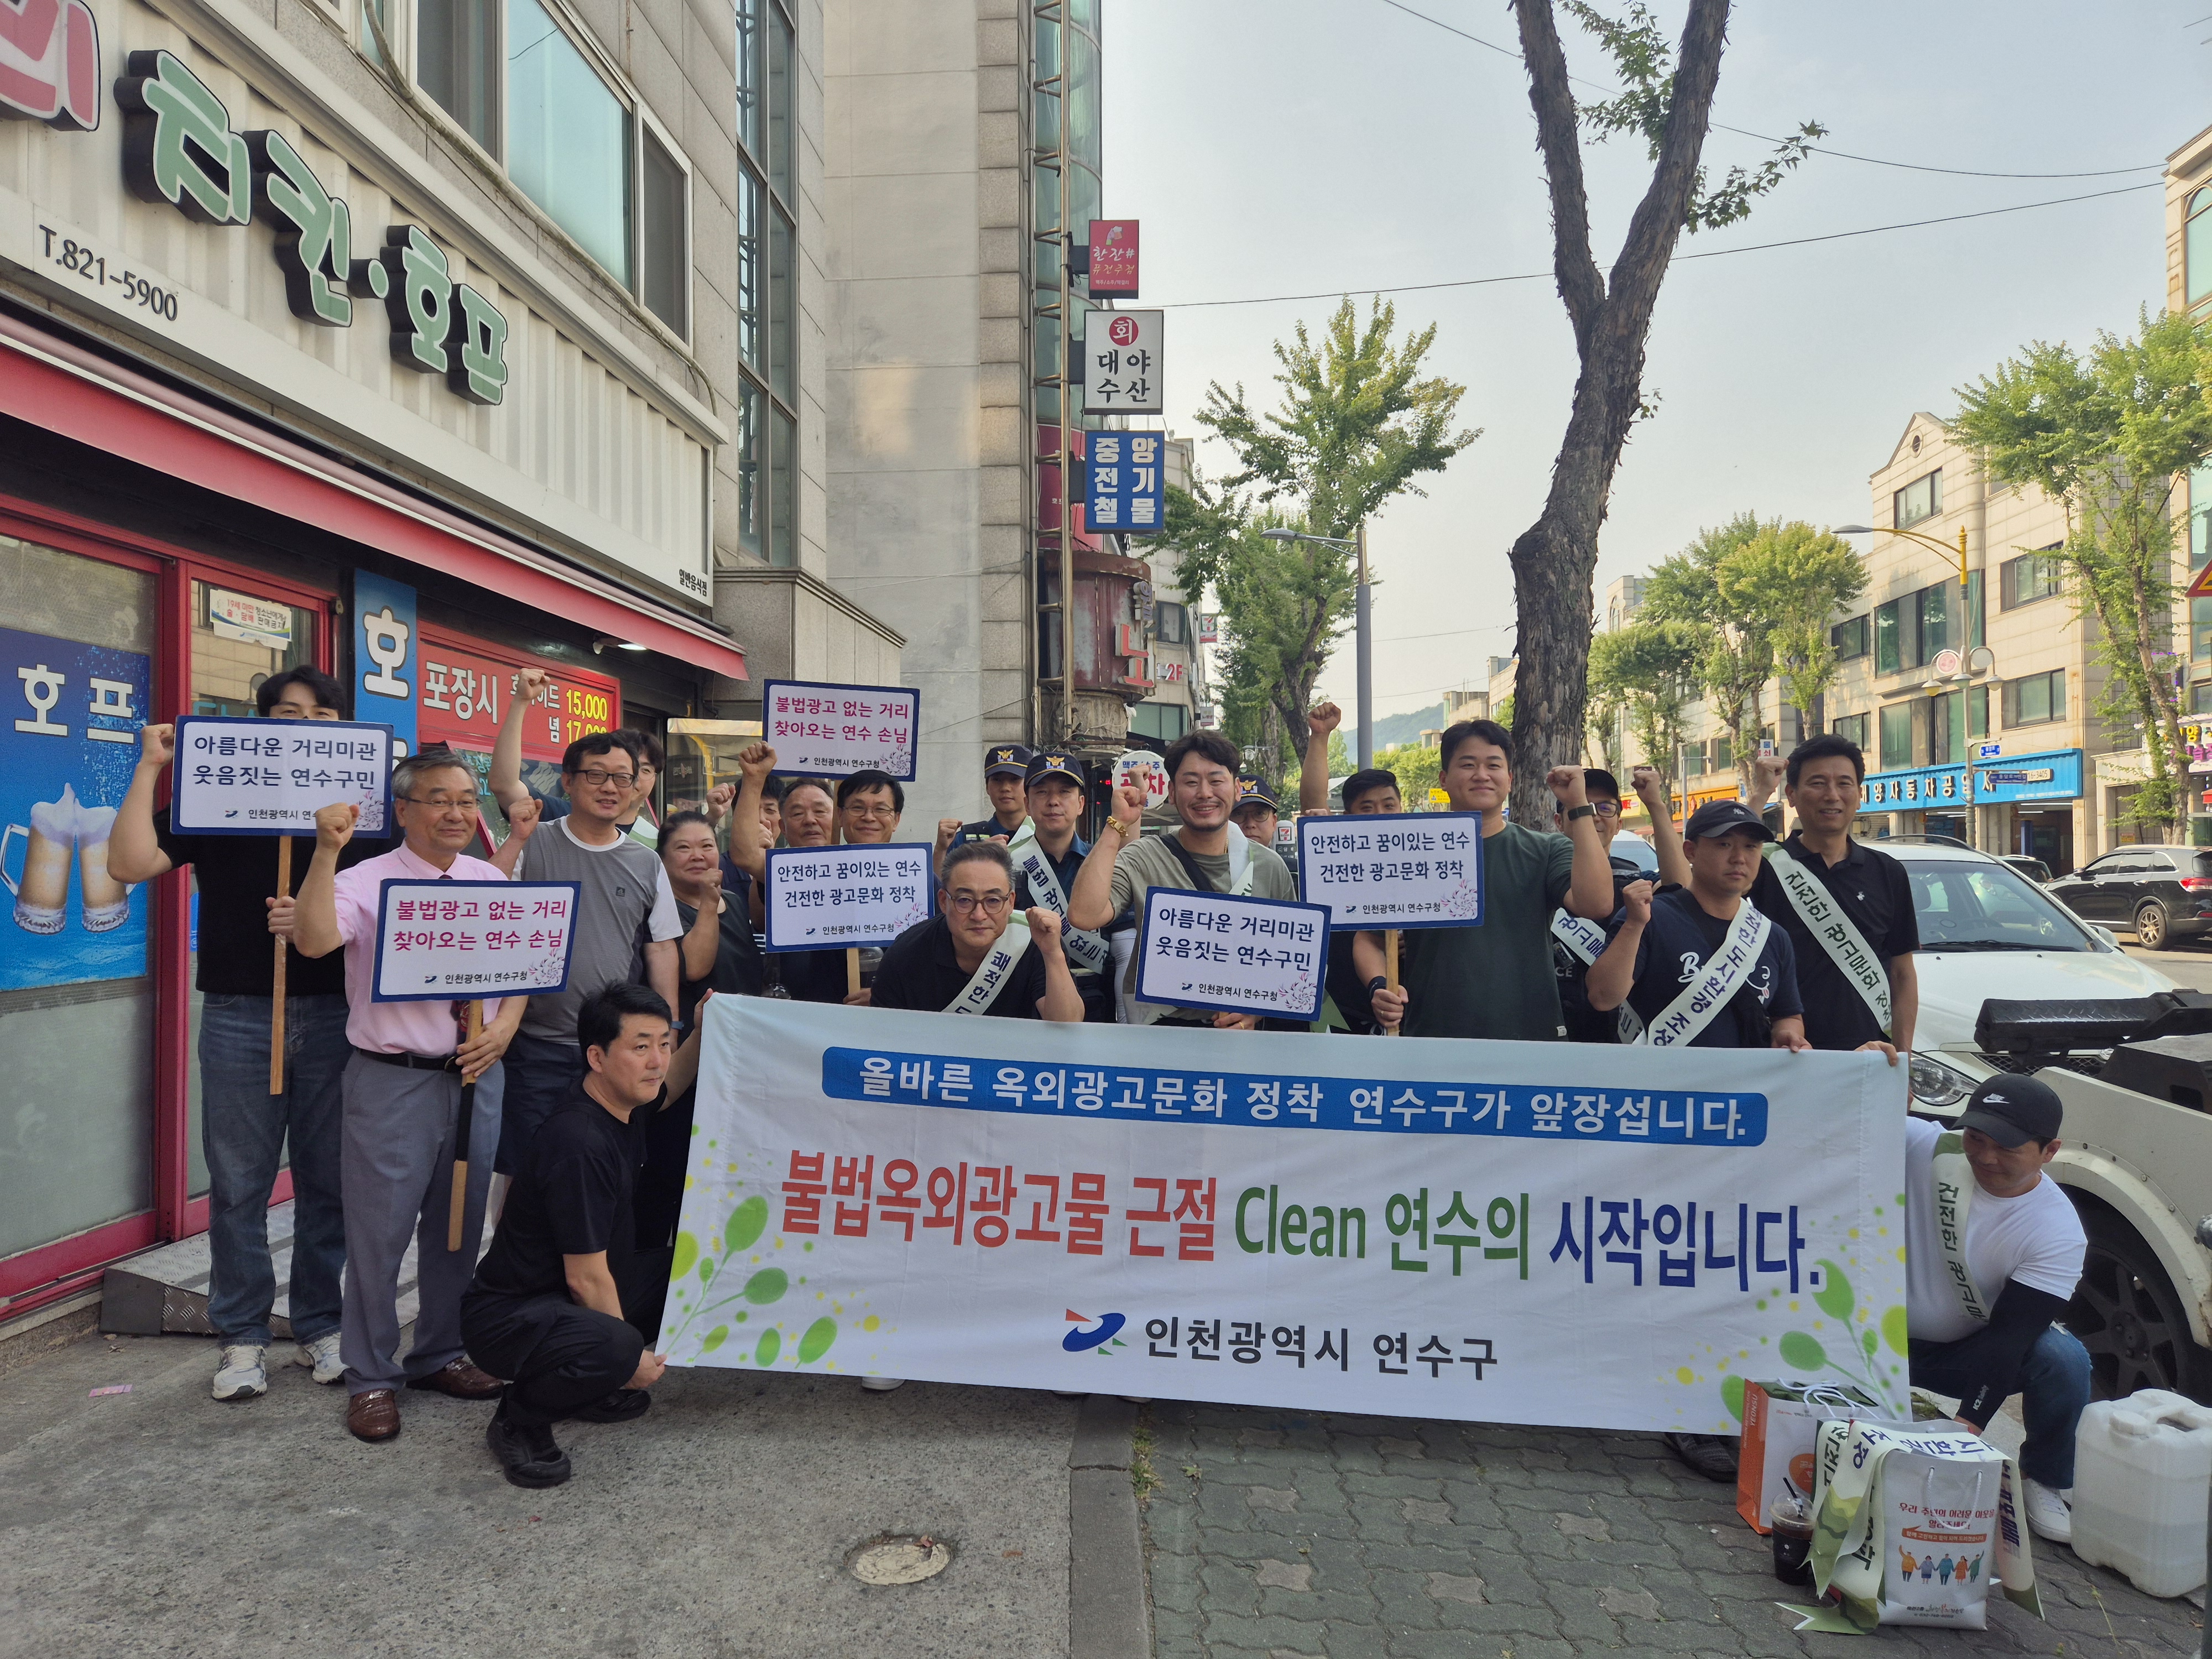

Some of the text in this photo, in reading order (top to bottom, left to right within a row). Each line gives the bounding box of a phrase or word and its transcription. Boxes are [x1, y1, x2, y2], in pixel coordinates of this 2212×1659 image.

[39, 223, 179, 321] T.821-5900
[1093, 264, 1135, 276] 퓨전주점
[1113, 319, 1133, 344] 회
[1097, 349, 1151, 375] 대야
[1097, 378, 1151, 404] 수산
[1095, 438, 1158, 463] 중앙
[1094, 468, 1155, 493] 전기
[1094, 497, 1156, 523] 철물
[679, 569, 707, 597] 일반음식점
[242, 602, 254, 614] 미만
[1165, 663, 1183, 681] 2F
[14, 664, 134, 744] 호프
[424, 661, 497, 724] 포장시
[566, 688, 608, 722] 15,000
[775, 696, 909, 719] 불법광고 없는 거리
[775, 720, 907, 744] 찾아오는 연수 손님
[194, 735, 377, 761] 아름다운 거리미관
[814, 758, 880, 768] 인천광역시 연수구청
[192, 764, 375, 790] 웃음짓는 연수구민
[248, 808, 298, 821] 인천광역시
[1311, 831, 1470, 854] 안전하고 꿈이있는 연수
[778, 860, 922, 883] 안전하고 꿈이있는 연수
[1321, 860, 1464, 883] 건전한 광고문화 정착
[785, 885, 916, 908] 건전한 광고문화 정착
[1362, 902, 1441, 914] 인천광역시 연수구청
[395, 899, 567, 921] 불법광고 없는 거리
[822, 924, 895, 935] 인천광역시 연수구청
[1159, 907, 1314, 942] 아름다운 거리미관
[1785, 870, 1832, 917] 건전한
[1824, 922, 1881, 991] 광고문화
[393, 928, 564, 952] 찾아오는 연수 손님
[1156, 936, 1311, 972] 웃음짓는 연수구민
[445, 971, 528, 985] 인천광역시 연수구청
[967, 951, 1012, 1005] 쾌적한
[1691, 945, 1747, 1014] 도시환경
[1198, 983, 1278, 1001] 인천광역시 연수구청
[1653, 1011, 1691, 1046] 조성
[859, 1056, 1746, 1141] 올바른 옥외광고문화 정착 연수구가 앞장섭니다.
[781, 1149, 1819, 1293] 불법옥외광고물 근절 Clean 연수의 시작입니다.
[1938, 1182, 1959, 1253] 건전한
[1145, 1316, 1498, 1381] 인천광역시 연수구
[1750, 1394, 1758, 1426] YEONSU
[1899, 1503, 1917, 1514] 우리
[1921, 1507, 1946, 1517] 주변의
[1949, 1509, 1972, 1519] 어려운
